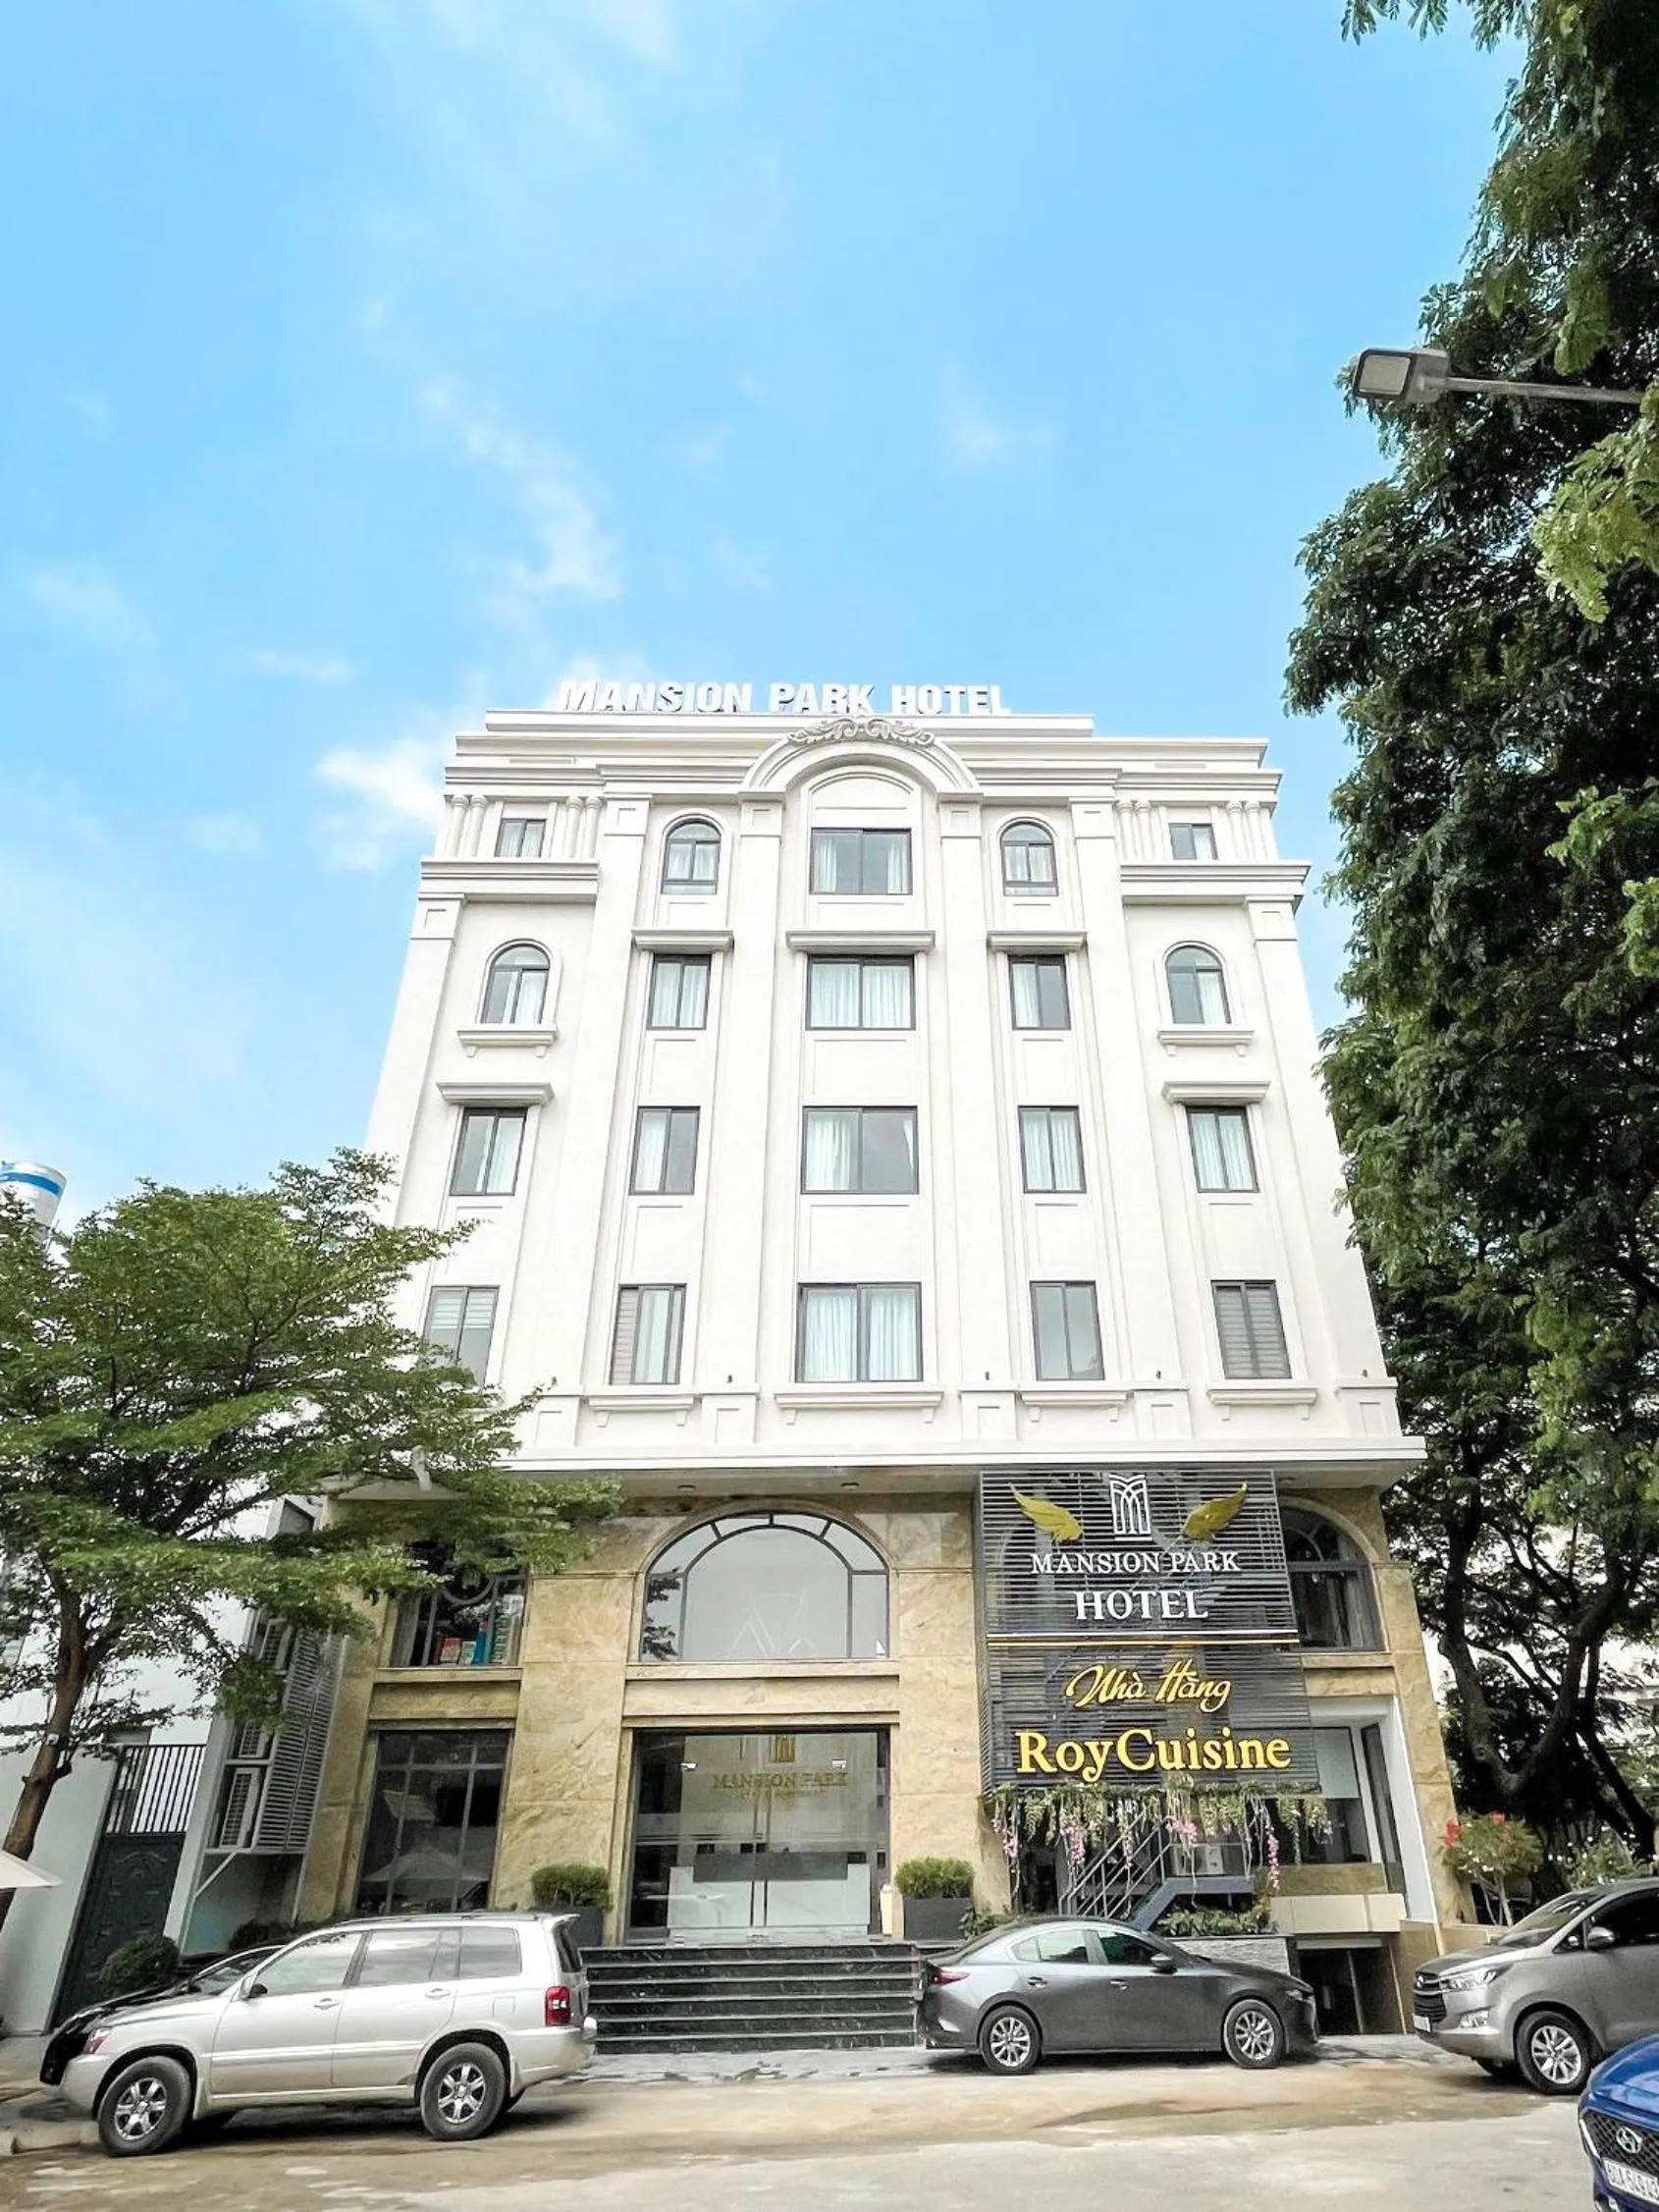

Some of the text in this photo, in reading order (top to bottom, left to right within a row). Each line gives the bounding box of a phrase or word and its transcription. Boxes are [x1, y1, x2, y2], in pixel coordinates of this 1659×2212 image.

[558, 678, 1012, 716] MANSION PARK HOTEL
[1029, 1550, 1241, 1574] MANSION PARK
[1073, 1589, 1209, 1620] HOTEL
[1065, 1663, 1147, 1709] Nhà
